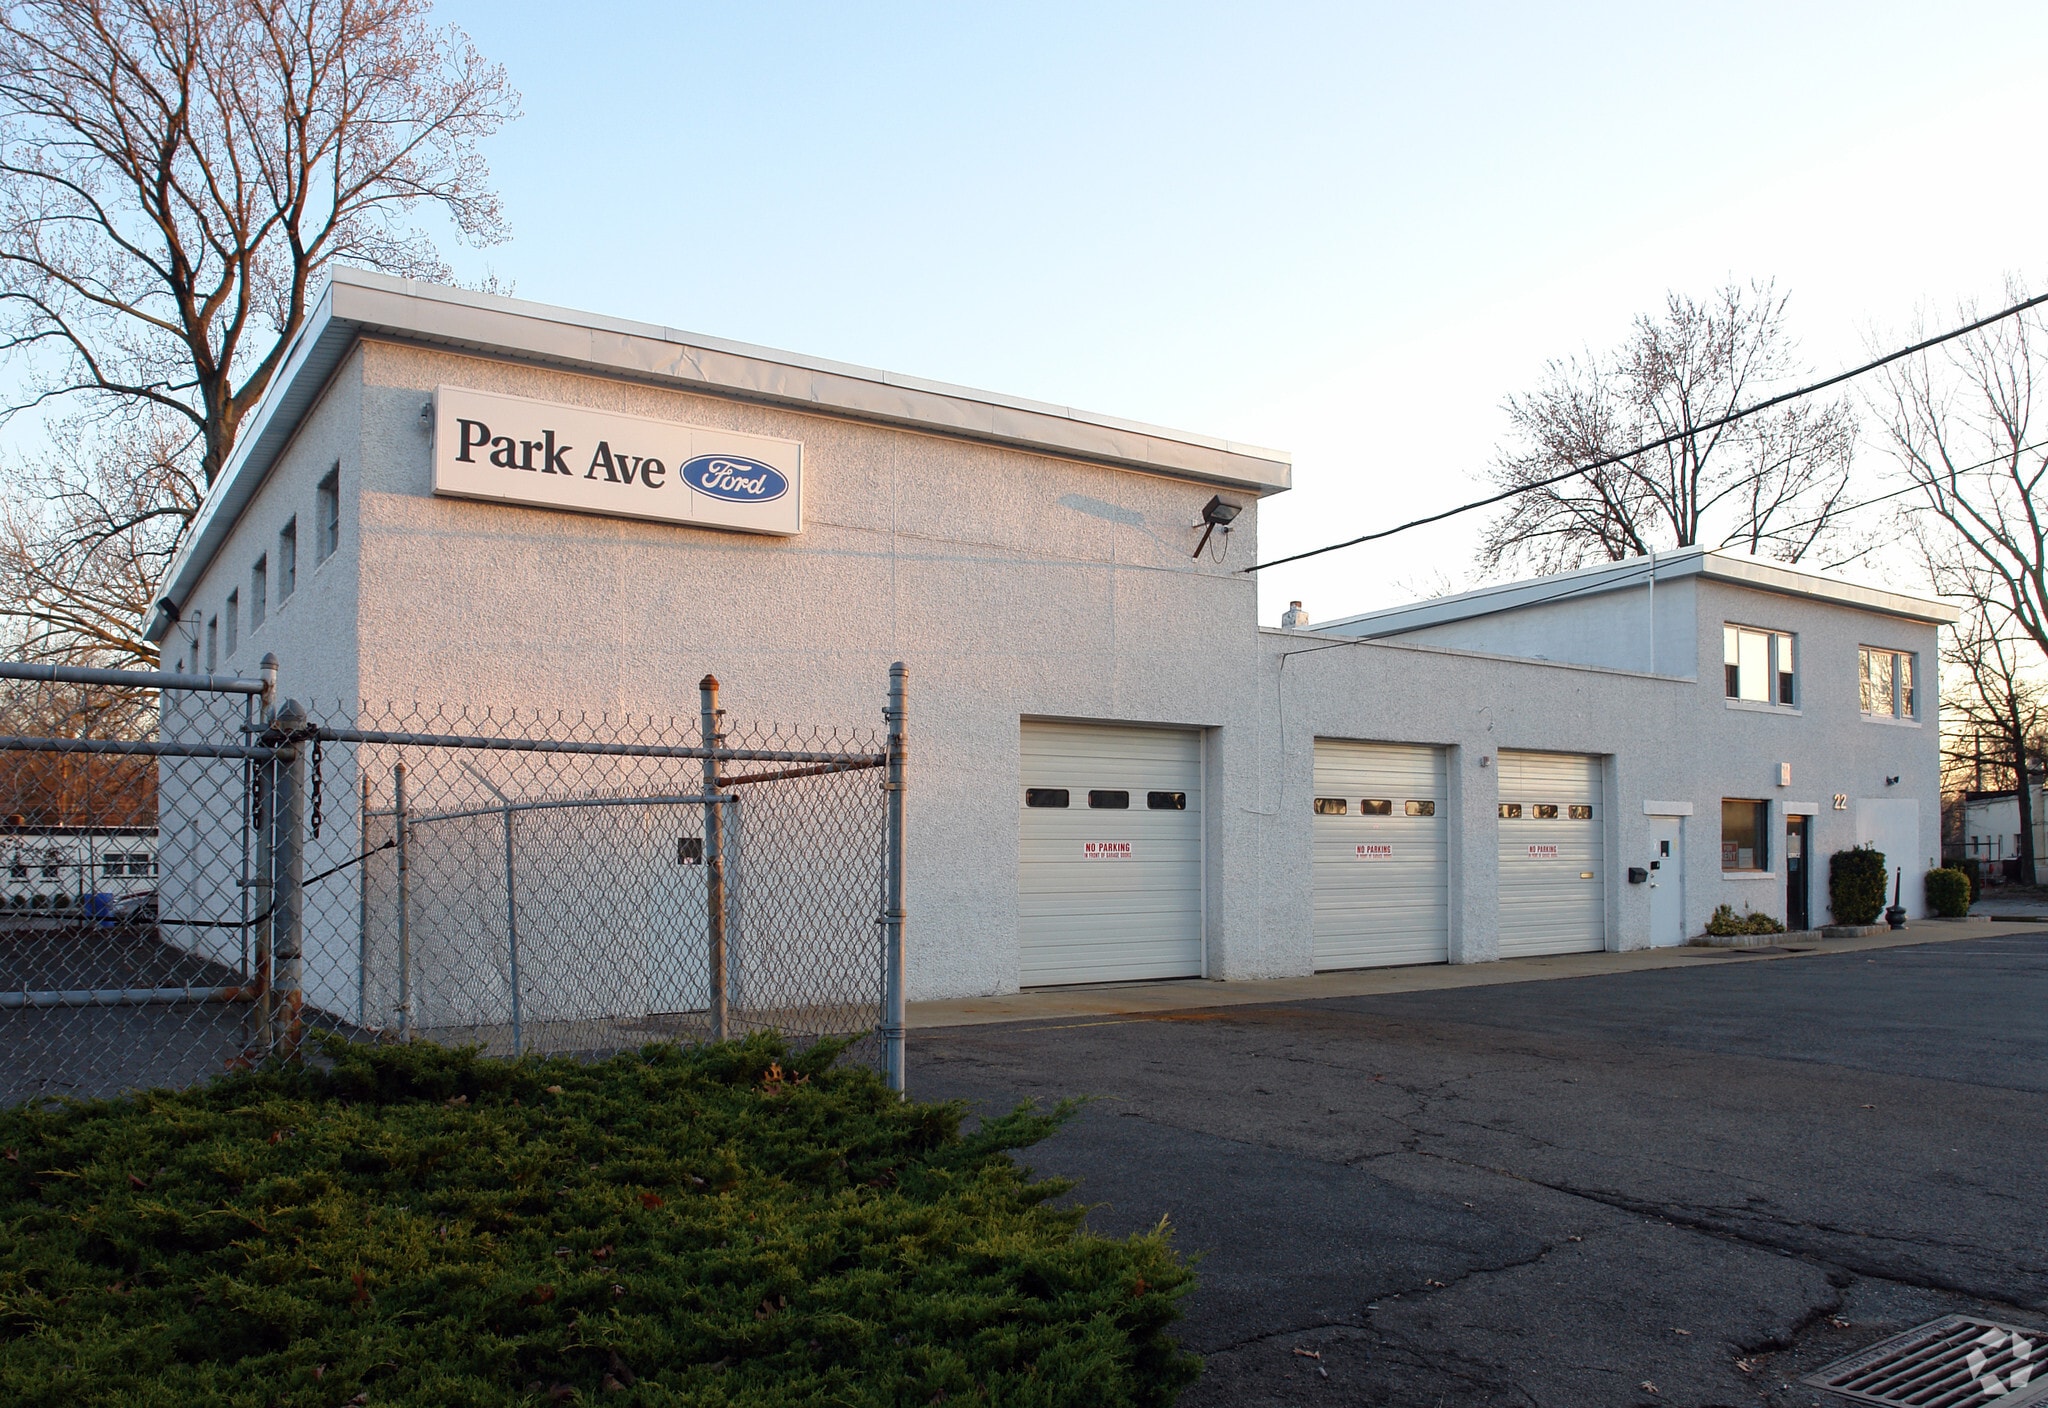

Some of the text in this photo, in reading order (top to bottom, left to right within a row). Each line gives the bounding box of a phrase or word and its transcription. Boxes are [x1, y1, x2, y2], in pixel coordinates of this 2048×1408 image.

[455, 418, 666, 489] Park Ave
[702, 459, 766, 496] Ford
[1834, 794, 1847, 810] 22
[1086, 843, 1130, 852] NO PARKING
[1357, 845, 1391, 853] NO PARKING
